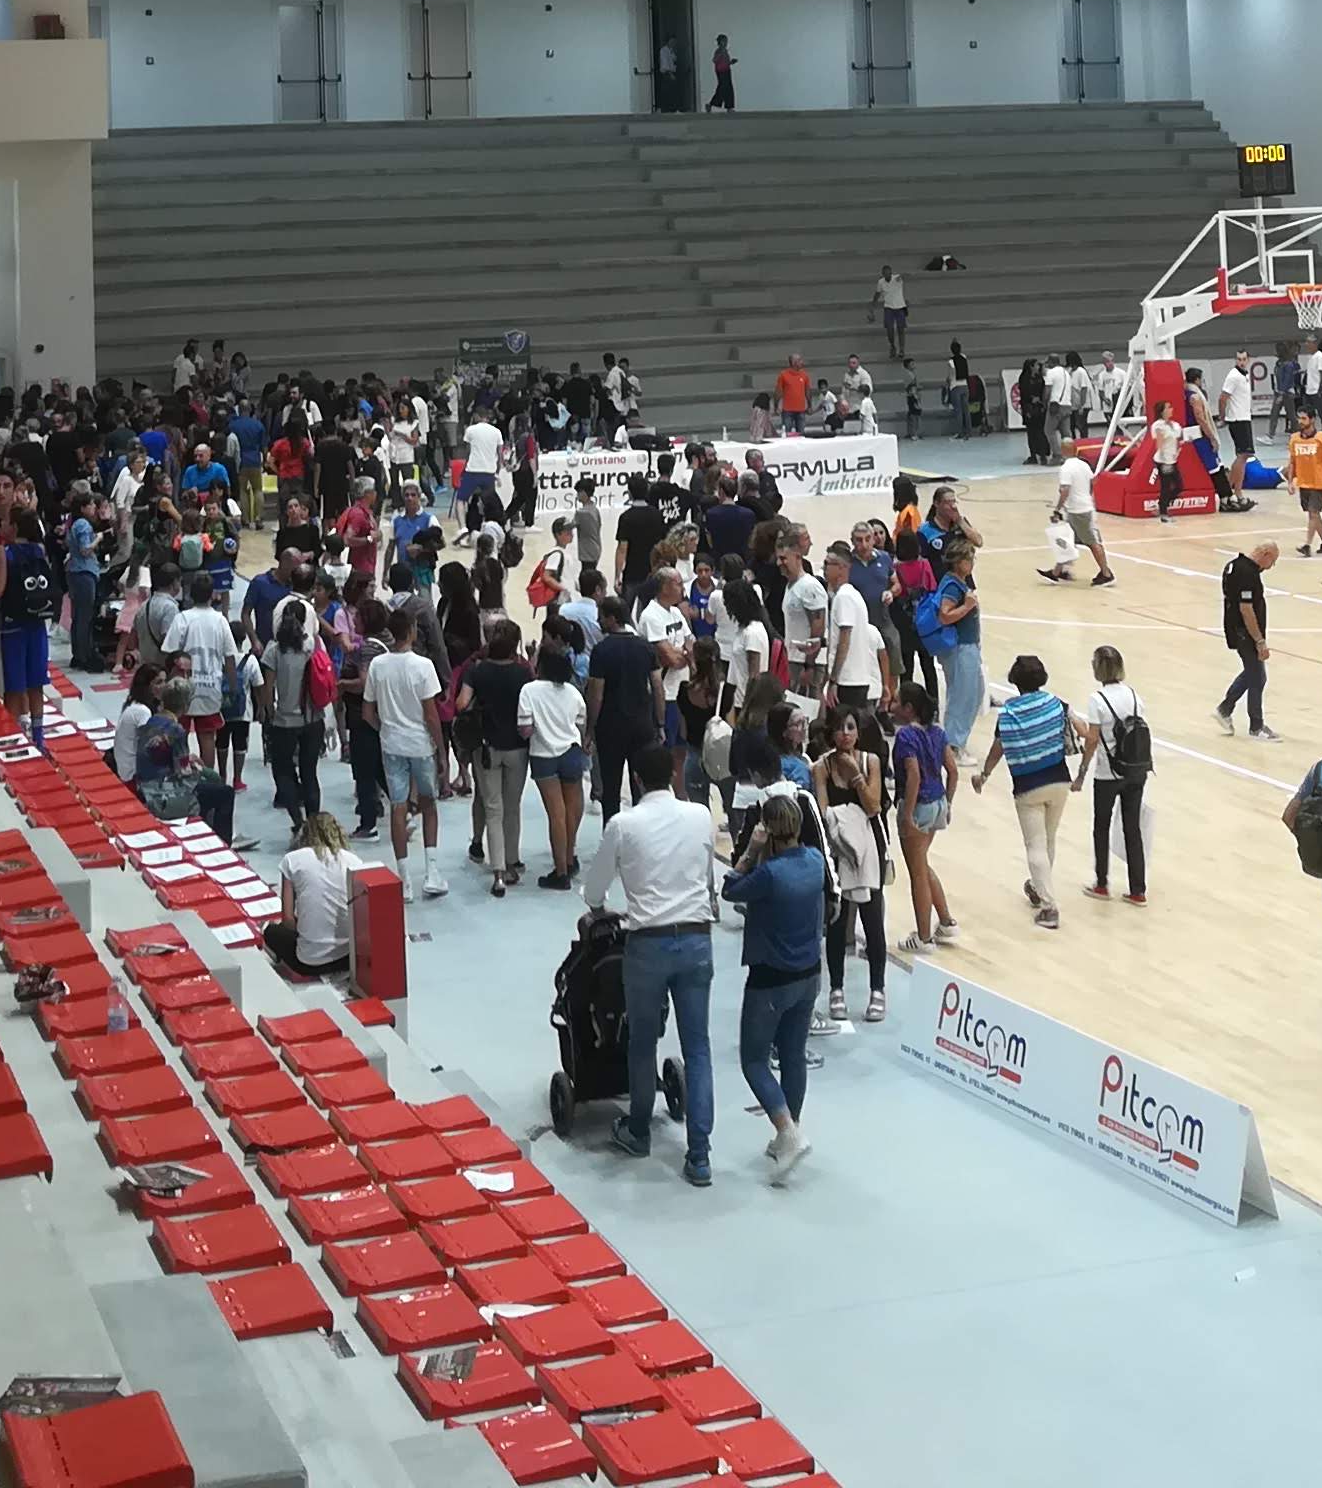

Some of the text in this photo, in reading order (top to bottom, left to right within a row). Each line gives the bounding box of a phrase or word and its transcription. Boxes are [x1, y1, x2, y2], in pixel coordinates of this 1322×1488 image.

[1245, 145, 1286, 162] 00:00
[538, 470, 573, 489] ttà
[809, 473, 893, 496] Ambiente
[1099, 1054, 1204, 1158] Pitcom
